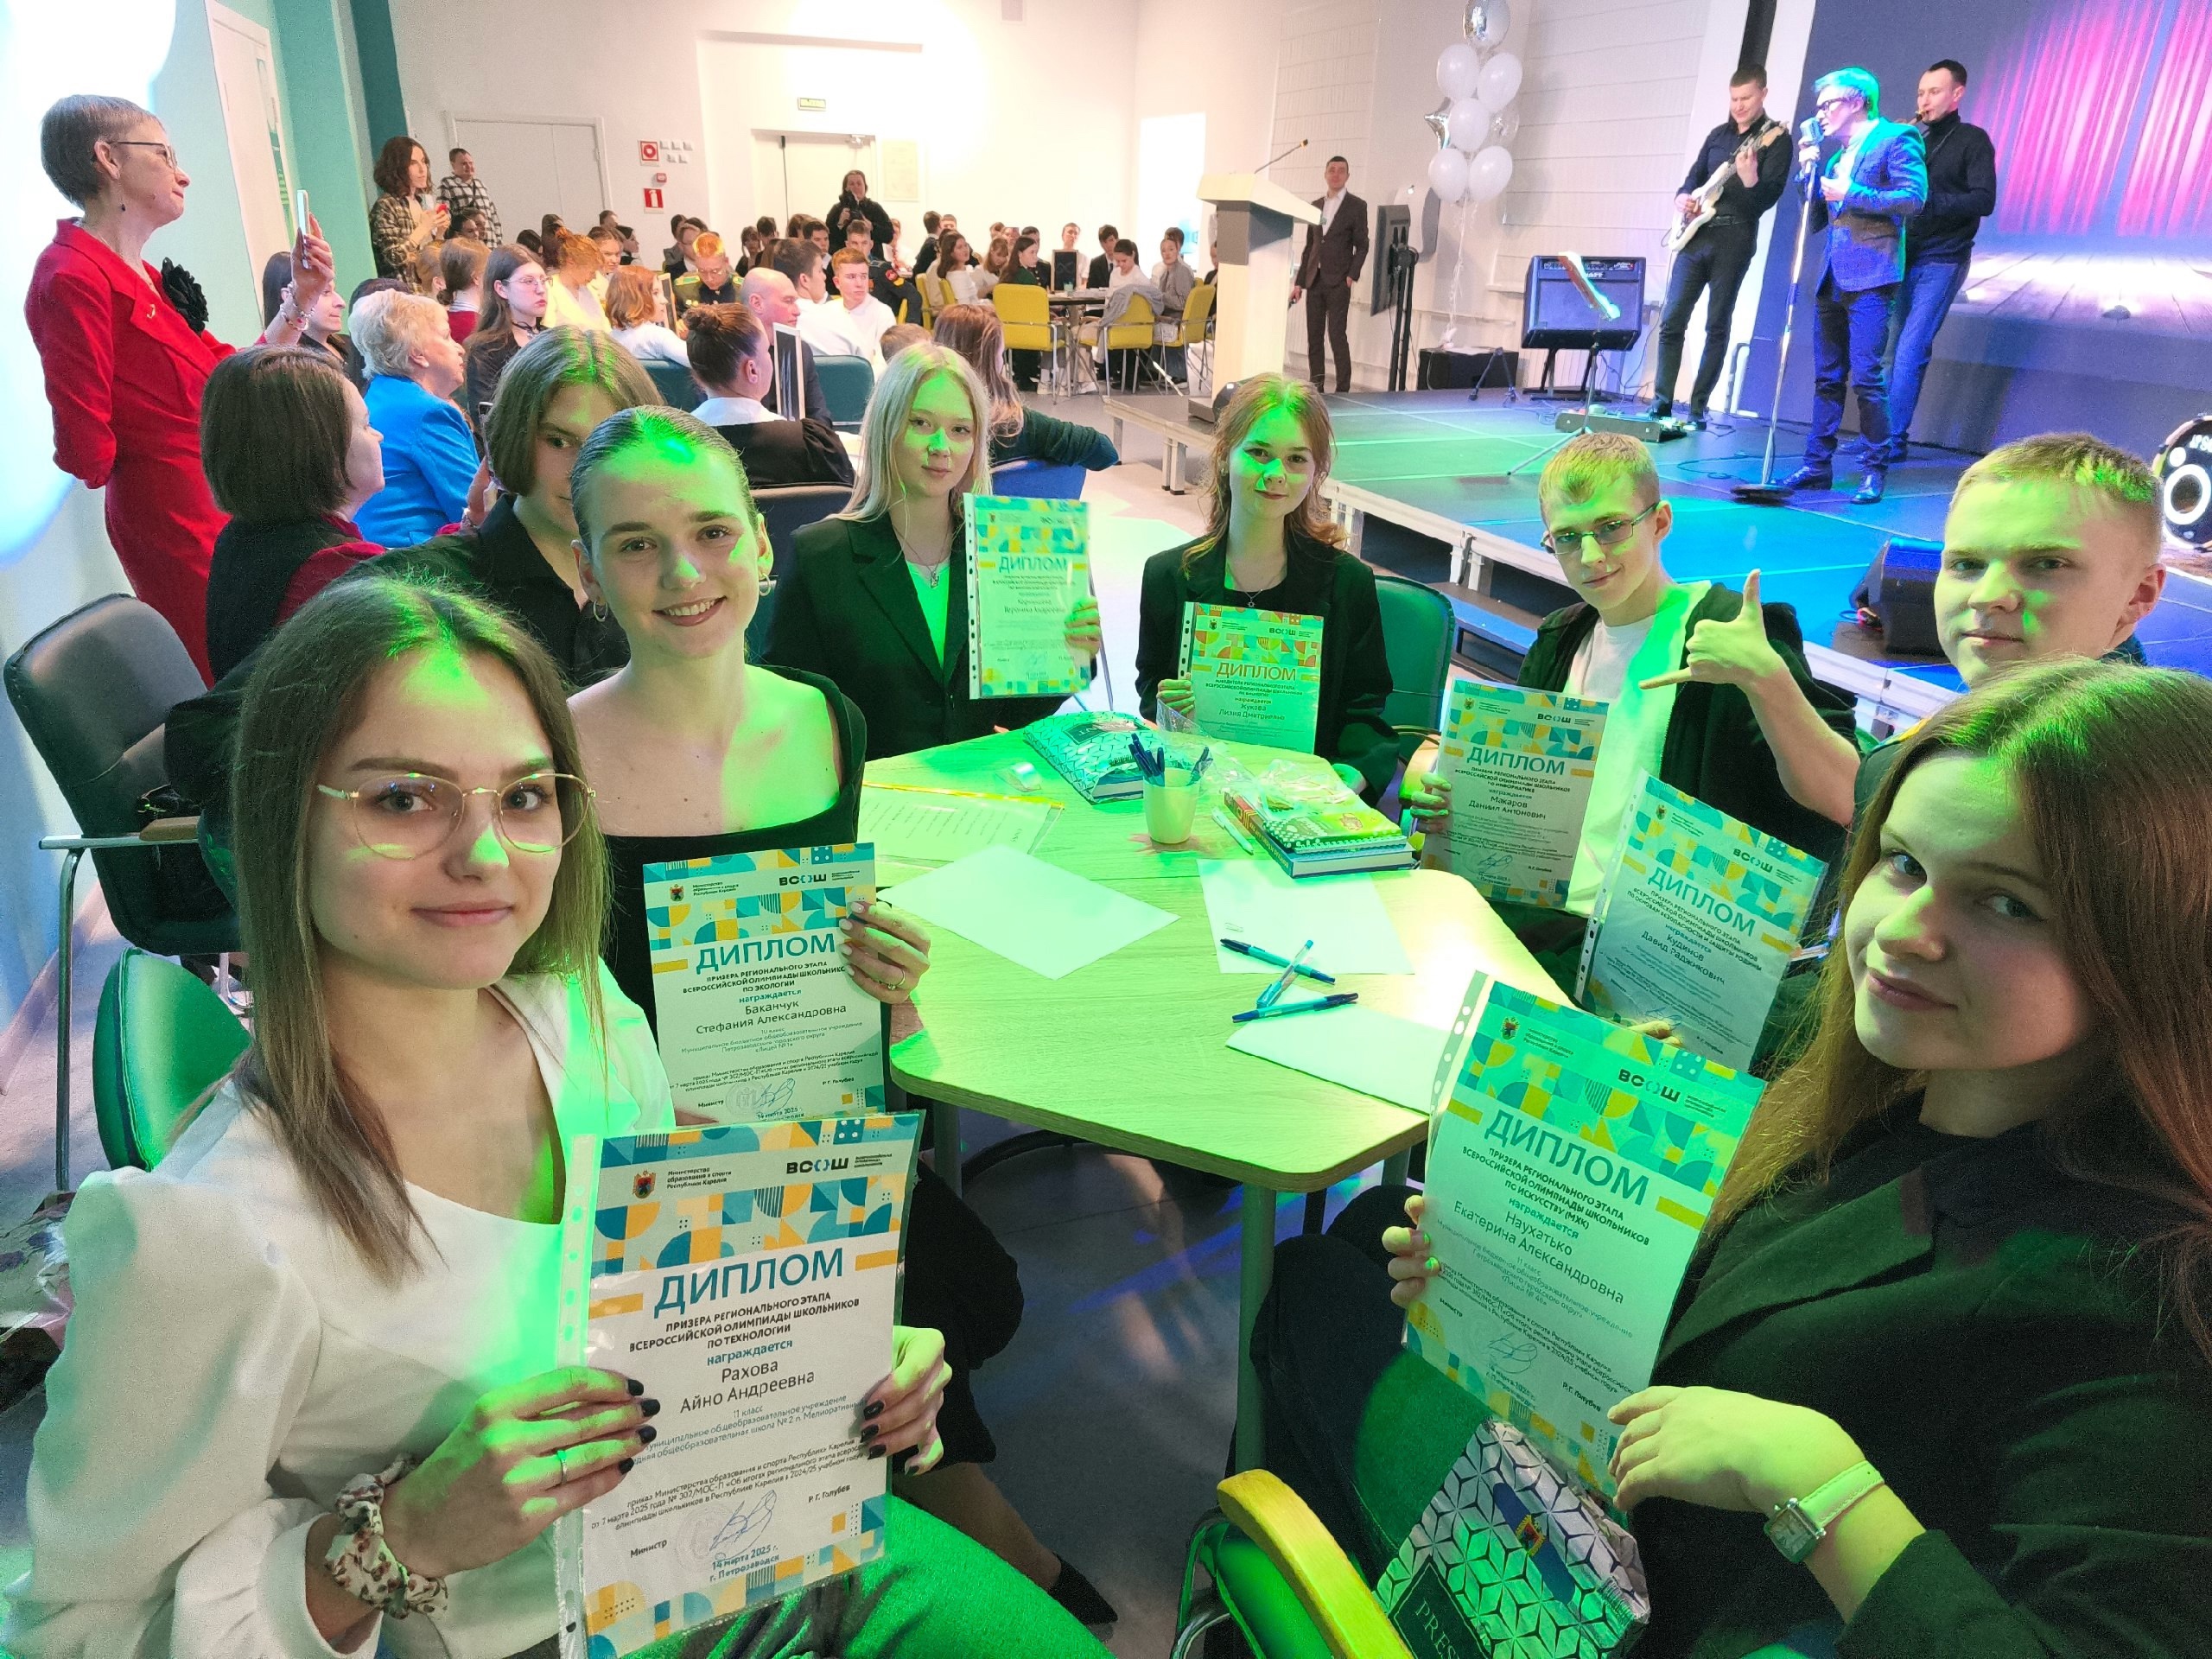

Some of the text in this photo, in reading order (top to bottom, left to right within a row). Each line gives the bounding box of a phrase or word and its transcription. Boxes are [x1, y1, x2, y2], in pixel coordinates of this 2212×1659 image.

[1216, 661, 1296, 683] ДИПЛОМ
[1240, 702, 1266, 711] Жукова
[1466, 746, 1565, 775] ДИПЛОМ
[1493, 770, 1539, 783] РЕГИОНАЛЬНОГО
[1468, 799, 1546, 819] Даниил Антонович
[1490, 795, 1528, 808] Макаров
[1631, 887, 1679, 916] ВСЕРОССИЙСКОЙ
[1676, 913, 1715, 938] ОЛИМПИАДЫ
[1647, 866, 1756, 937] ДИПЛОМ
[1673, 903, 1722, 934] РЕГИОНАЛЬНОГО
[1721, 931, 1741, 945] ЭТАПА
[696, 932, 835, 975] ДИПЛОМ
[1640, 931, 1668, 952] Давид
[683, 972, 798, 993] ВСЕРОССИЙСКОЙ ОЛИМПИАДЫ
[706, 972, 739, 982] ПРИЗЕРА
[741, 964, 803, 977] РЕГИОНАЛЬНОГО
[754, 979, 794, 990] ЭКОЛОГИИ
[739, 989, 801, 1003] награждается
[745, 1001, 798, 1014] Баканчук
[696, 1005, 846, 1033] Стефания Александровна
[1484, 1109, 1649, 1205] ДИПЛОМ
[1462, 1146, 1649, 1245] ВСЕРОССИЙСКОЙ ОЛИМПИАДЫ ШКОЛЬНИКОВ
[1488, 1147, 1623, 1221] ПРИЗЕРА РЕГИОНАЛЬНОГО ЭТАПА
[1504, 1179, 1589, 1230] ПО ИСКУССТВУ (МХК)
[1508, 1198, 1579, 1239] награждается
[1504, 1211, 1572, 1255] Наухатько
[1453, 1199, 1624, 1304] Екатерина Александровна
[653, 1247, 842, 1319] ДИПЛОМ
[629, 1298, 859, 1352] ВСЕРОССИЙСКОЙ ОЛИМПИАДЫ ШКОЛЬНИКОВ
[665, 1291, 830, 1332] ПРИЗЕРА РЕГИОНАЛЬНОГО ЭТАПА
[707, 1323, 791, 1349] ПО ТЕХНОЛОГИИ
[707, 1339, 792, 1366] награждается
[721, 1360, 778, 1382] Рахова
[680, 1371, 814, 1414] Айно Андреевна
[710, 1406, 800, 1433] общеобразовательное
[801, 1395, 846, 1413] учреждение
[734, 1405, 763, 1418] 11 класс
[657, 1426, 748, 1458] общеобразовательная
[751, 1421, 774, 1433] школа
[626, 1494, 652, 1508] приказ
[654, 1478, 708, 1497] Министерства
[709, 1465, 755, 1484] образования
[762, 1457, 786, 1469] спорта
[607, 1511, 629, 1523] марта
[630, 1503, 647, 1516] 2025
[650, 1498, 665, 1509] года
[630, 1539, 667, 1558] Министр
[711, 1559, 722, 1570] 14
[723, 1554, 748, 1567] марта
[750, 1544, 771, 1559] 2025
[717, 1554, 779, 1579] Петрозаводск
